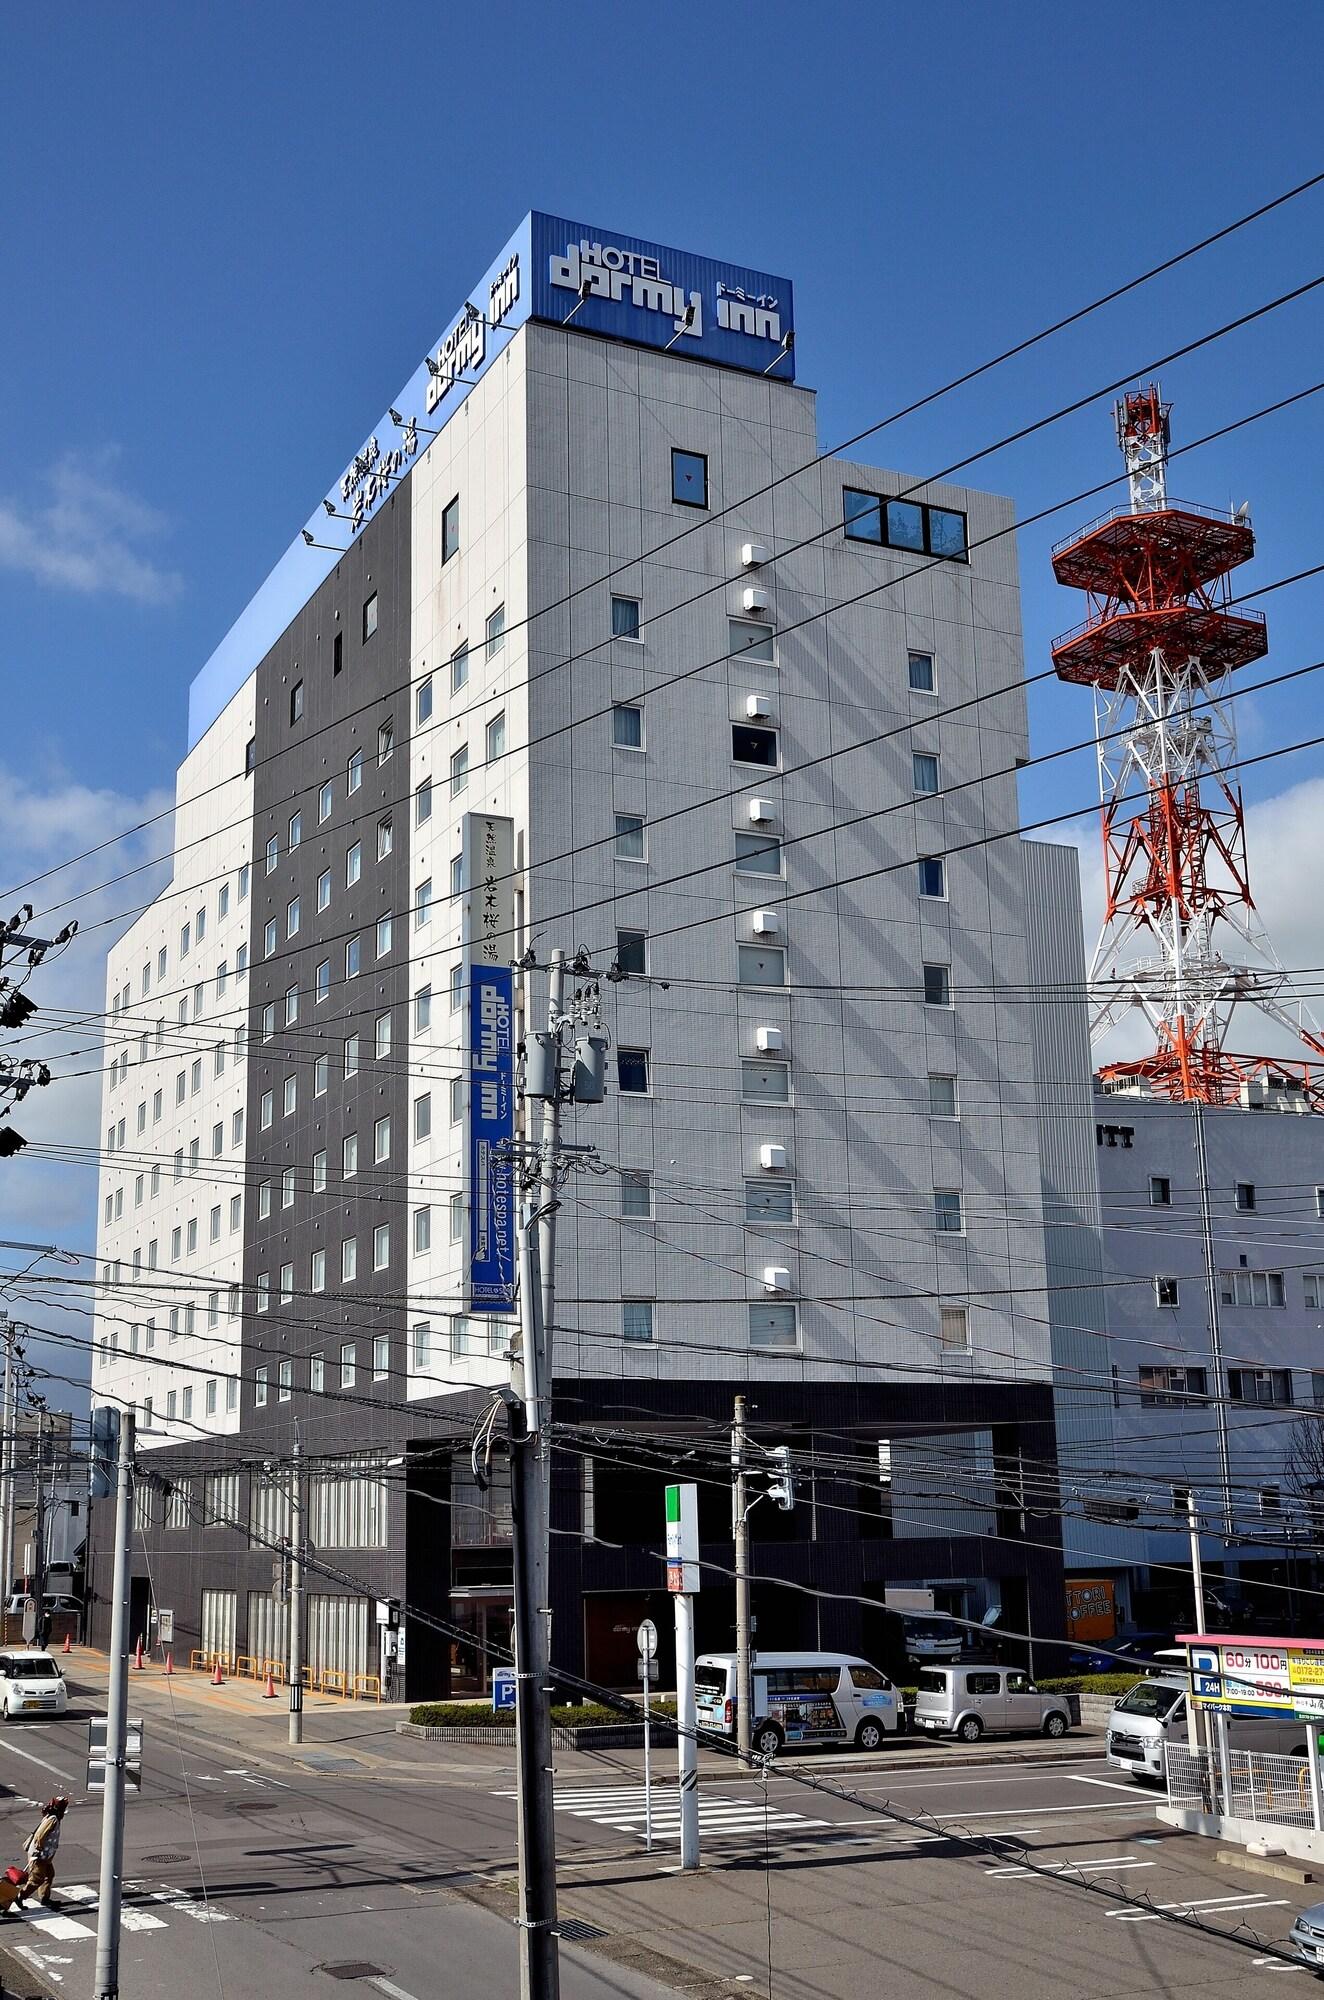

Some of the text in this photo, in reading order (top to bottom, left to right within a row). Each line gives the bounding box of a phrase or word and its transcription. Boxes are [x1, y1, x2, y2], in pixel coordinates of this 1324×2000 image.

[580, 239, 672, 284] HOTEL
[490, 266, 520, 332] inn
[550, 244, 780, 341] dormy inn
[716, 281, 778, 309] ドーミーイン
[483, 821, 500, 962] 天然温泉 岩木桜の湯
[497, 1003, 509, 1055] HOTEL
[472, 985, 505, 1119] dormy inn
[1067, 1600, 1112, 1620] OFFEE
[1192, 1649, 1219, 1691] P
[1226, 1651, 1251, 1668] 60分
[1253, 1653, 1287, 1670] 100円
[501, 1684, 513, 1700] P
[1205, 1682, 1220, 1693] 24H
